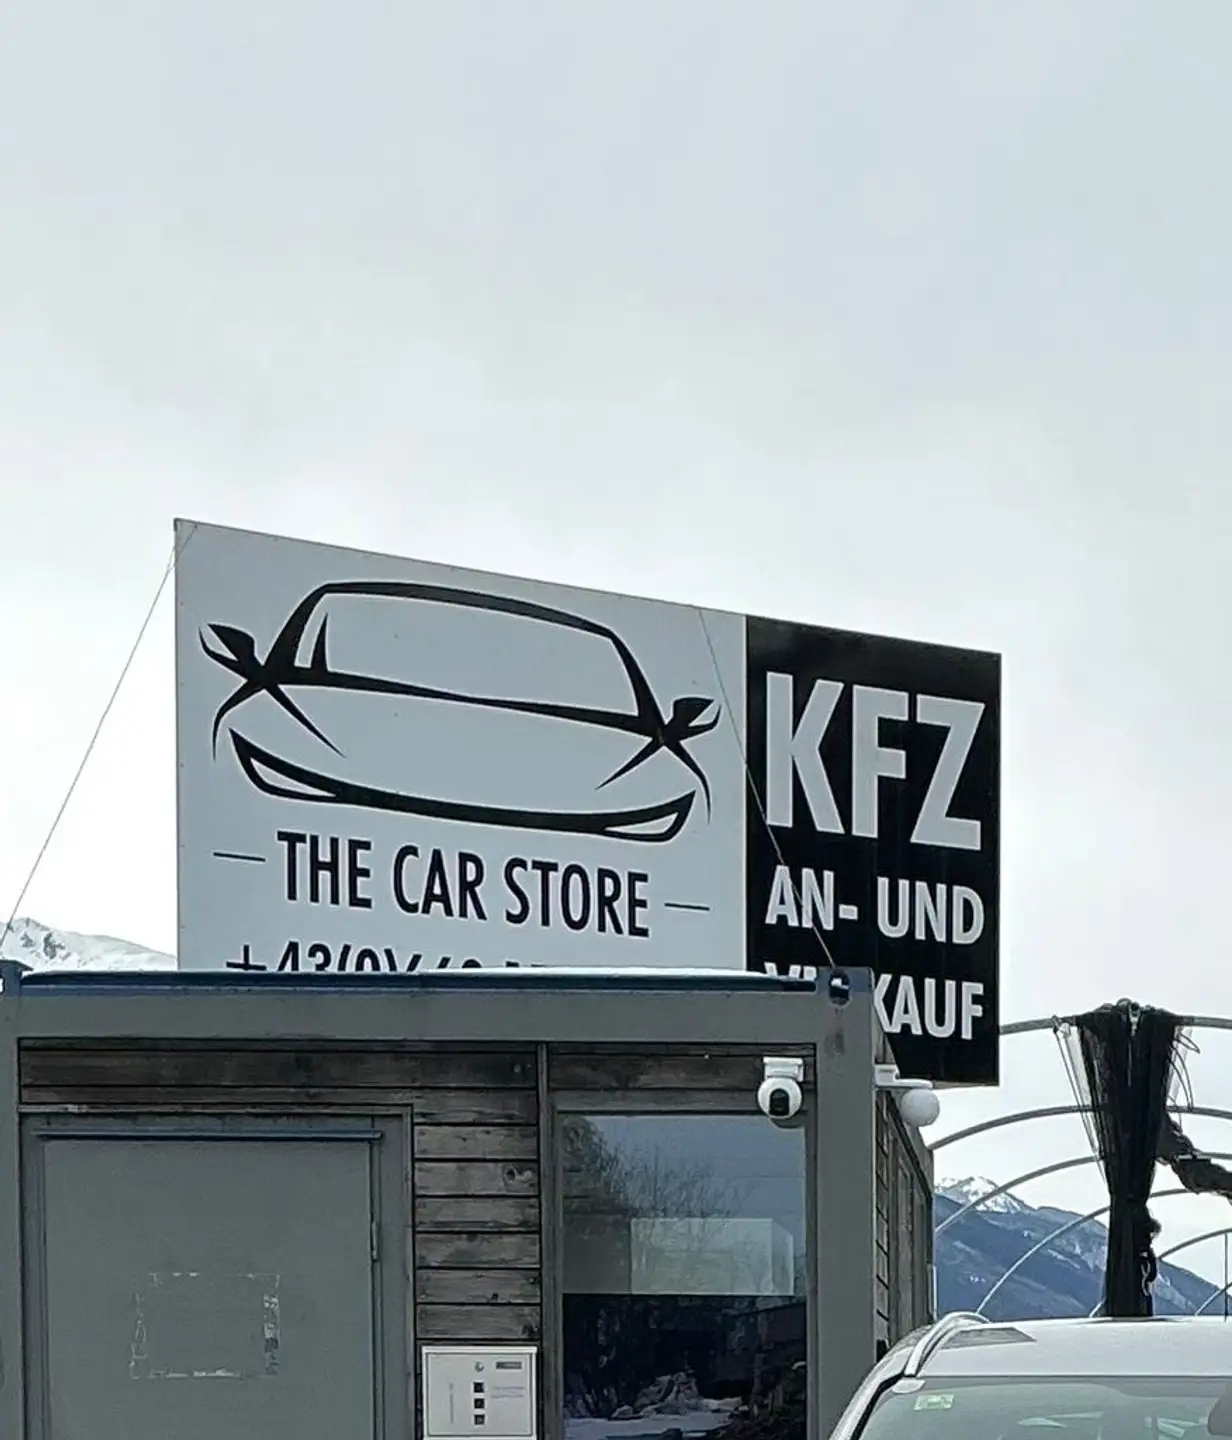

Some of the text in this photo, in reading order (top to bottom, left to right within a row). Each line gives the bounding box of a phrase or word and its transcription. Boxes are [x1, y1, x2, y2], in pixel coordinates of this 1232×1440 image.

[765, 671, 986, 851] KFZ
[276, 830, 651, 939] THE CAR STORE
[765, 865, 985, 946] AN- UND
